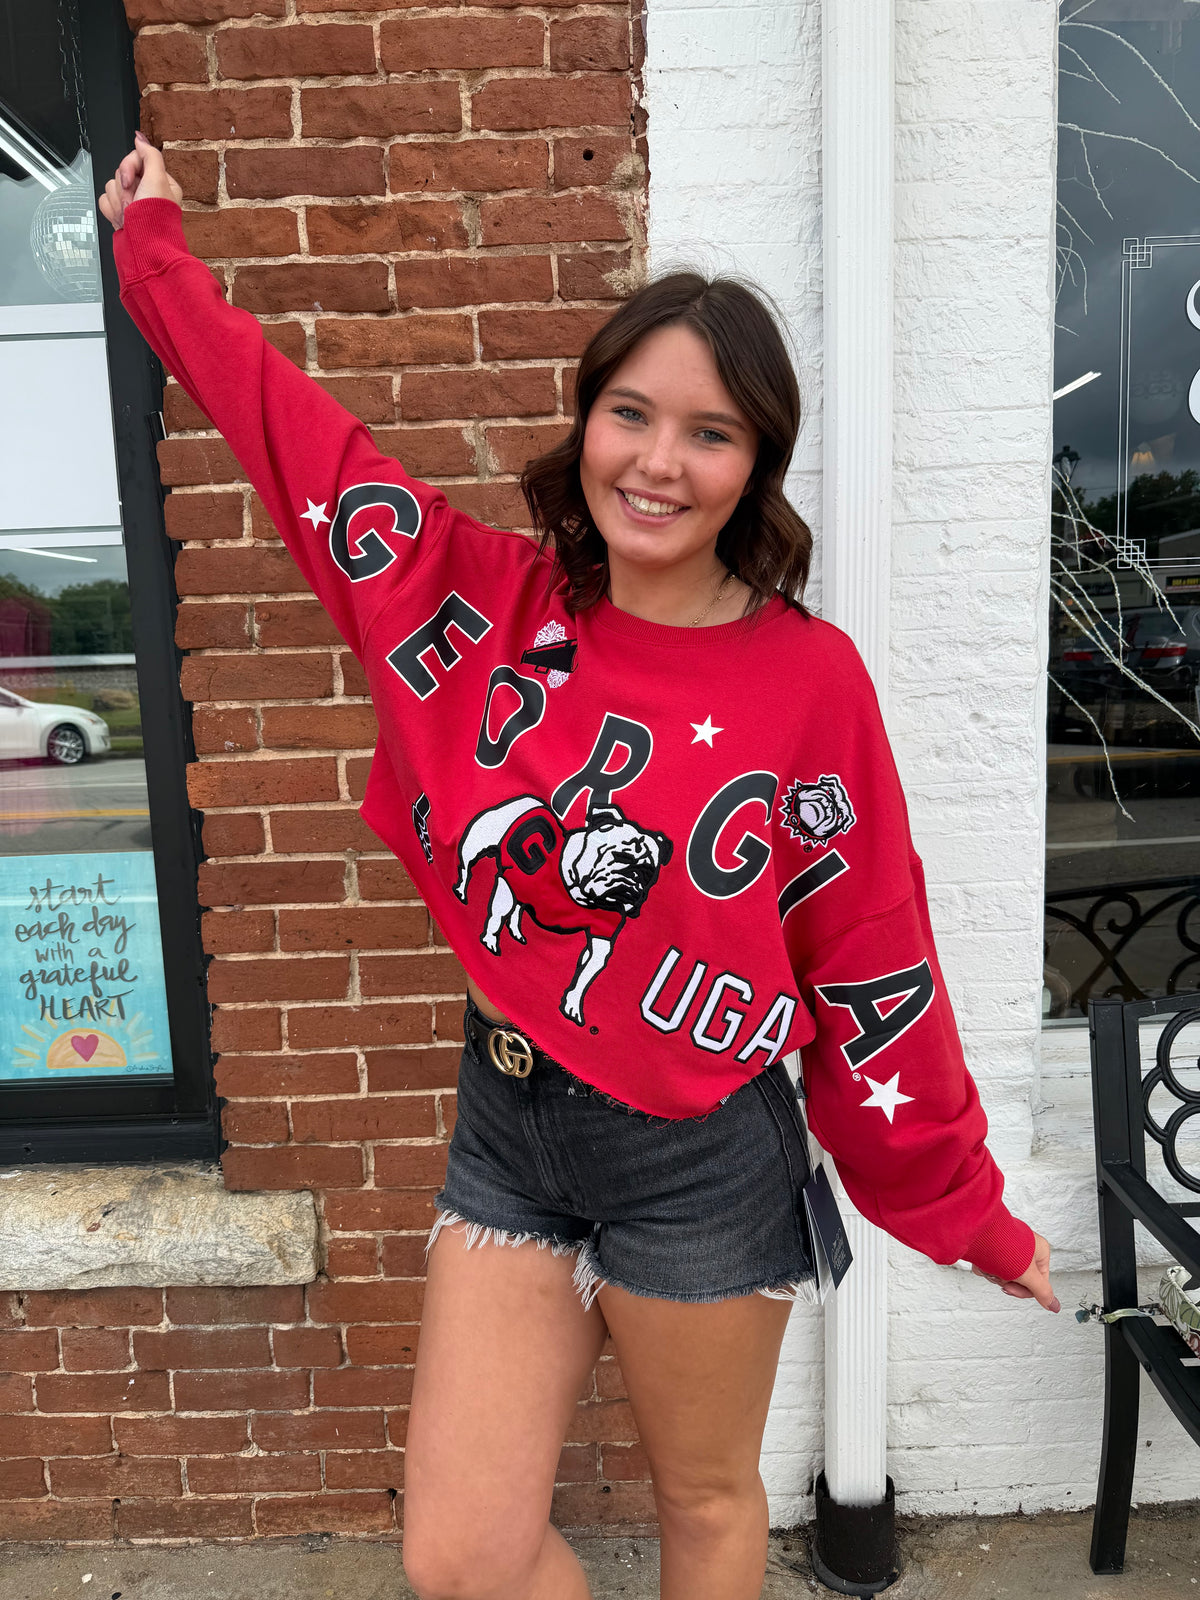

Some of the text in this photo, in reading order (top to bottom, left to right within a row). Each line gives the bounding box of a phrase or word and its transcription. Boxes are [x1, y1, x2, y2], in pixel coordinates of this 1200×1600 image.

[329, 482, 935, 1071] GEORGIA
[506, 815, 557, 875] G
[25, 873, 121, 913] start
[15, 906, 136, 954] each day
[35, 941, 107, 964] with a
[19, 958, 138, 1000] grateful
[40, 989, 134, 1021] HEART
[639, 945, 799, 1068] UGA
